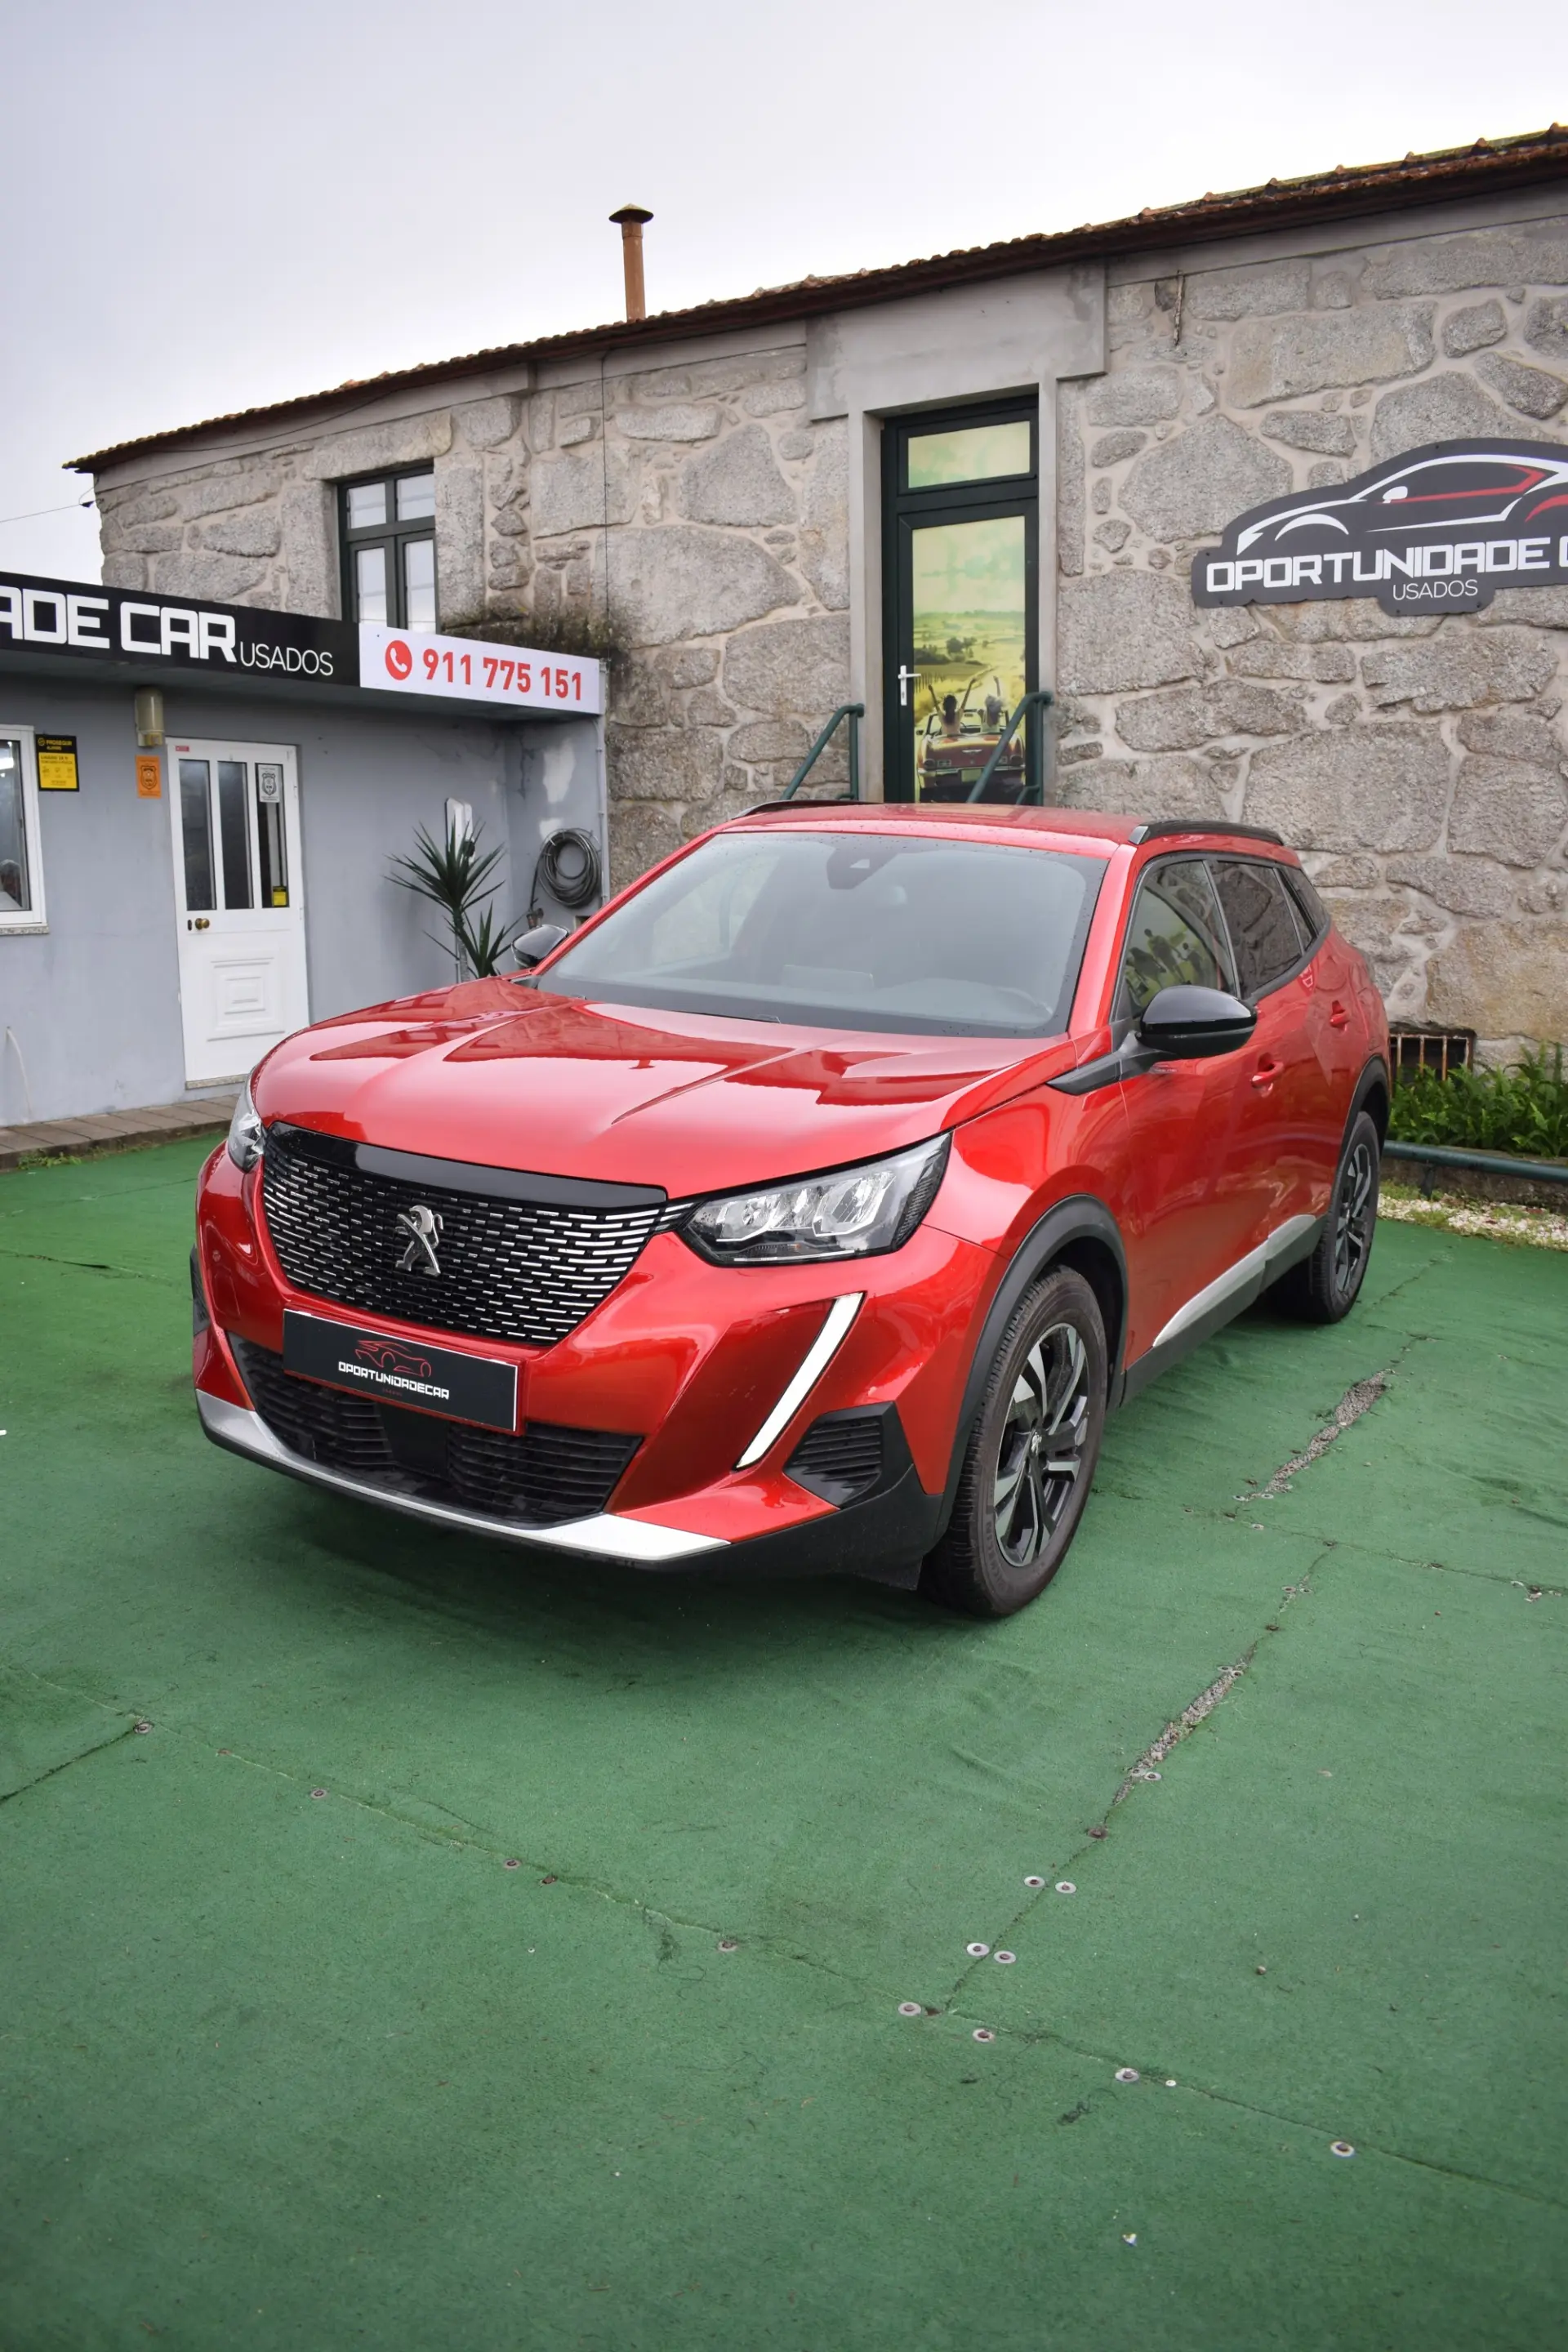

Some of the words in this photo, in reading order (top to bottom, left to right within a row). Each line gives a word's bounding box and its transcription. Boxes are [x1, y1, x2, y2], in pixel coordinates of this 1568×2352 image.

[1206, 537, 1551, 592] OPORTUNIDADE
[1392, 579, 1478, 600] USADOS
[120, 601, 237, 663] CAR
[239, 641, 333, 676] USADOS
[423, 648, 470, 685] 911
[483, 657, 531, 693] 775
[541, 666, 581, 701] 151
